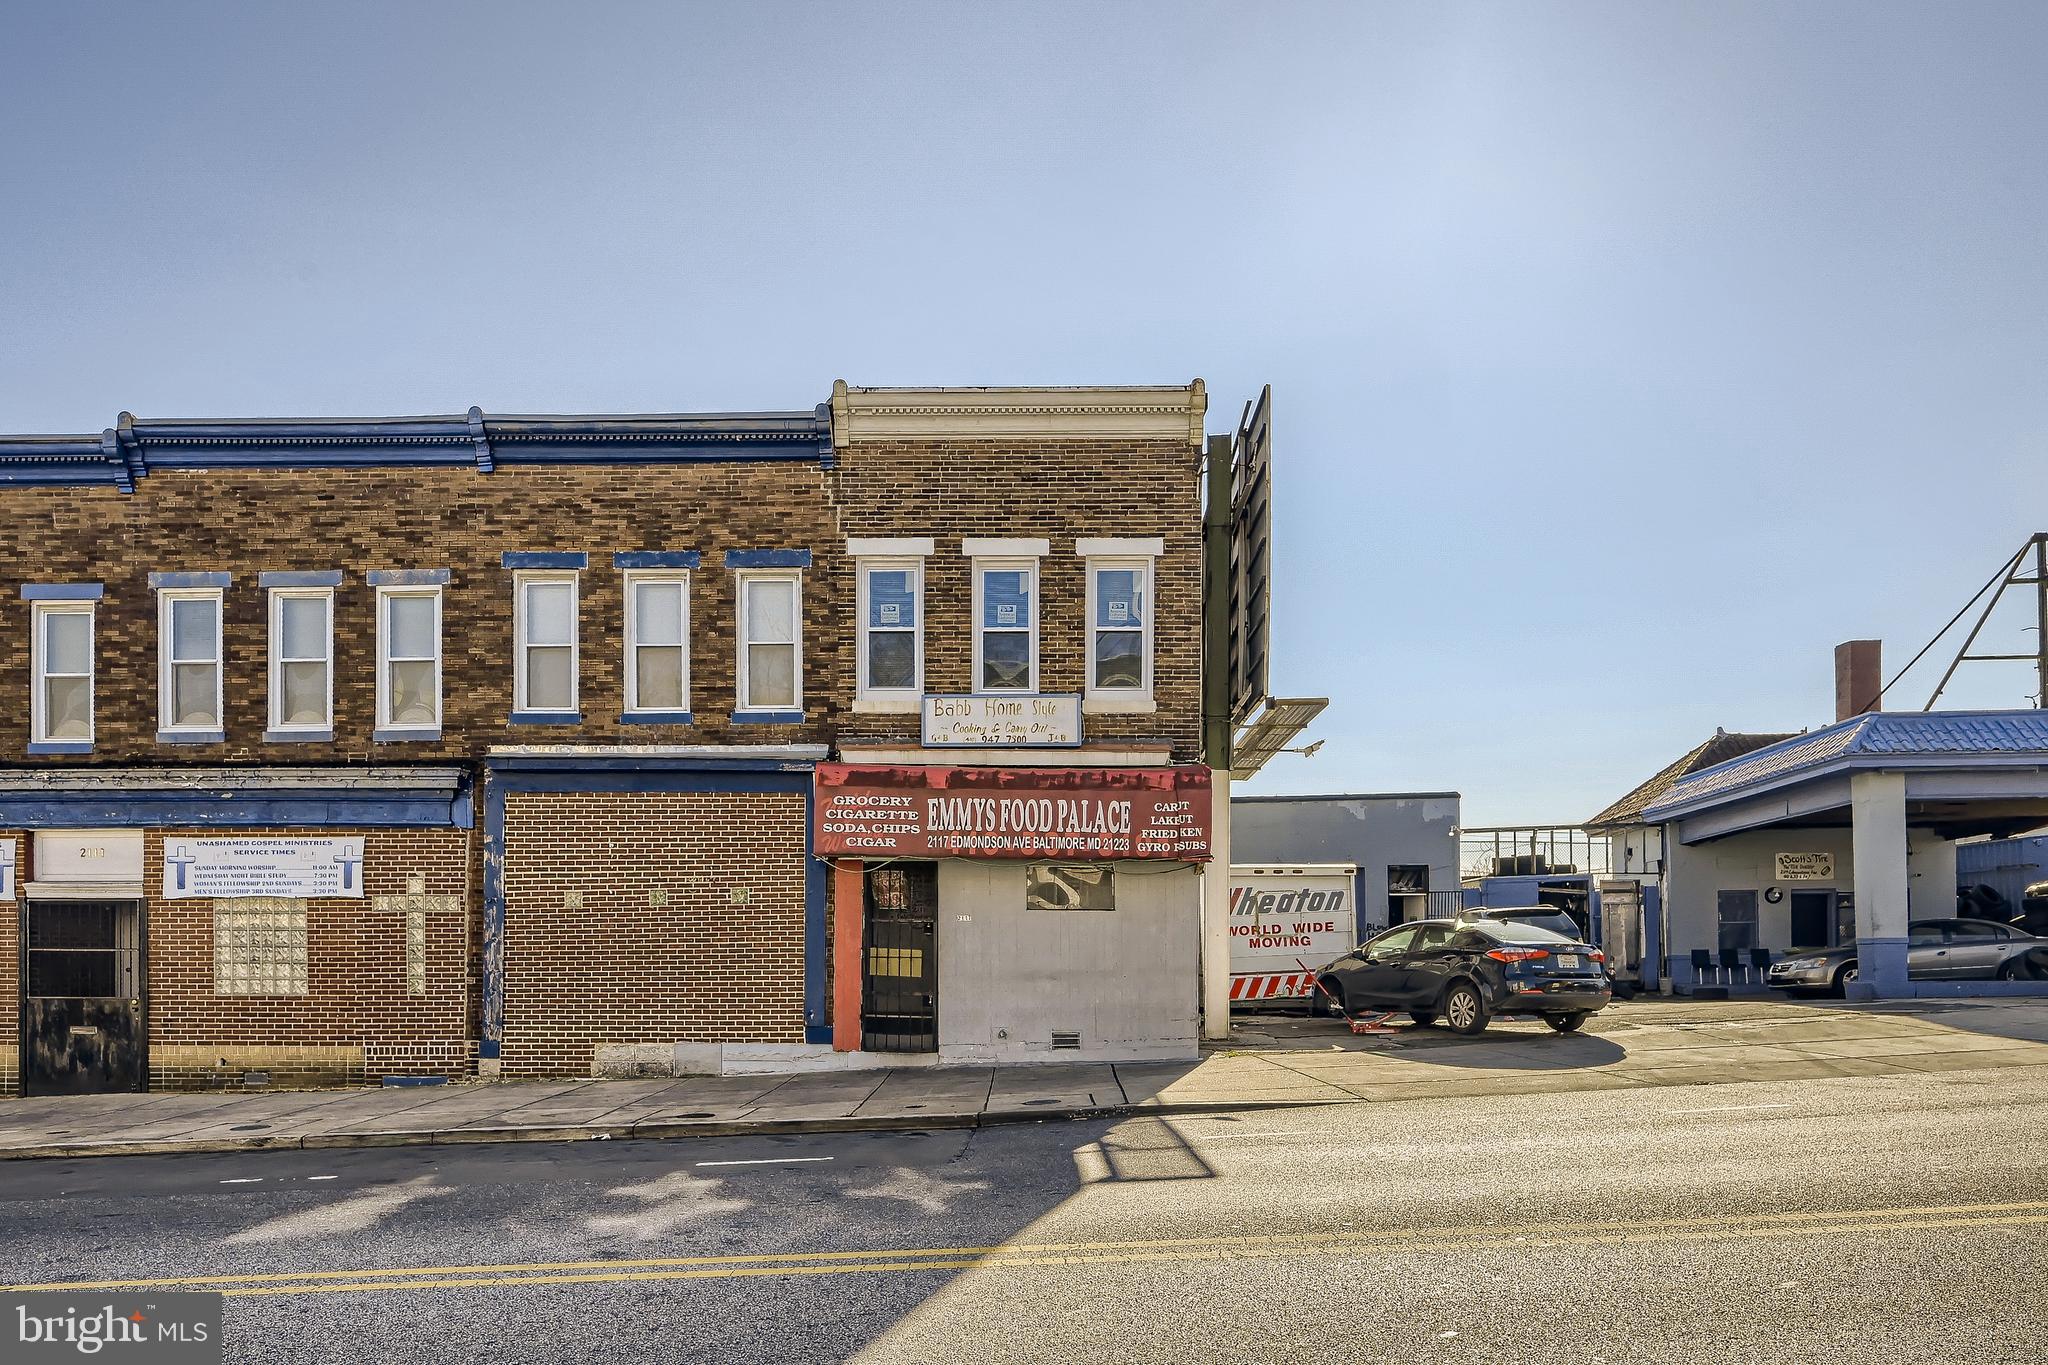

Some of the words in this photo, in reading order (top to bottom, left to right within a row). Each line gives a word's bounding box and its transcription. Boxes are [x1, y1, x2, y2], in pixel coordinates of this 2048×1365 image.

[933, 698, 971, 717] Babb
[985, 699, 1022, 718] Home
[952, 721, 987, 735] Cooking
[981, 735, 1000, 743] 947
[833, 795, 913, 806] GROCERY
[825, 809, 919, 820] CIGARETTE
[927, 797, 996, 832] EMMYS
[999, 798, 1053, 832] FOOD
[1056, 799, 1131, 834] PALACE
[1141, 829, 1178, 839] FRIED
[845, 836, 897, 848] CIGAR
[927, 836, 948, 849] 2117
[950, 835, 1011, 849] EDMONDSON
[1012, 836, 1031, 849] AVE
[1033, 836, 1085, 851] BALTIMORE
[1087, 837, 1101, 850] MD
[1102, 837, 1130, 851] 21223
[1137, 842, 1170, 852] GYRO
[1292, 922, 1334, 934] WIDE
[1249, 936, 1311, 949] MOVING
